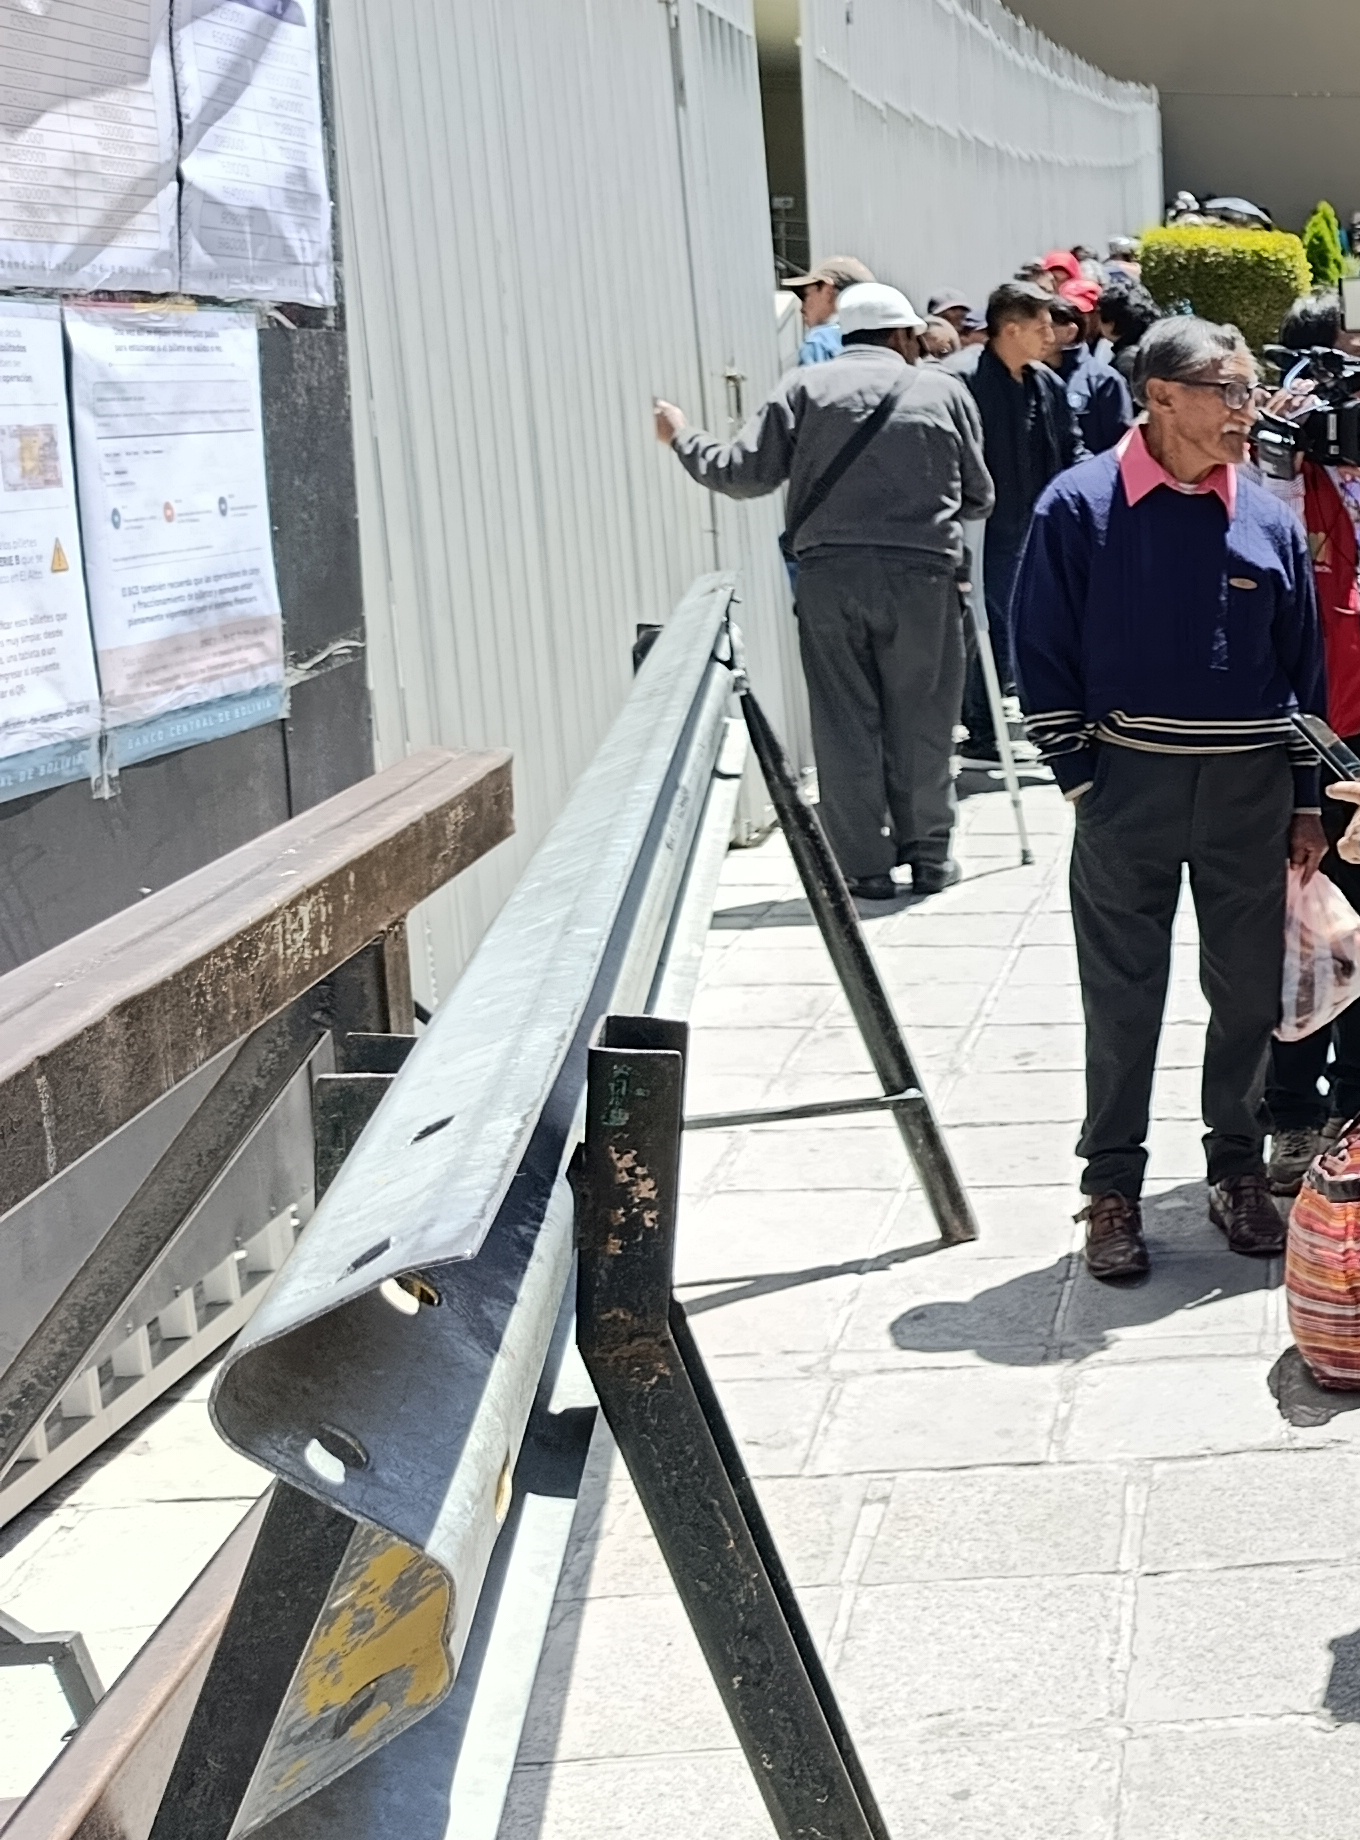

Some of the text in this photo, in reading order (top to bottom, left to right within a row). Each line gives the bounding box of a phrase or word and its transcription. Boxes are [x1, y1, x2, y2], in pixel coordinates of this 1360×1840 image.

[170, 716, 215, 738] CENTRAL
[217, 710, 231, 723] DE
[234, 699, 273, 719] BOLIVIA
